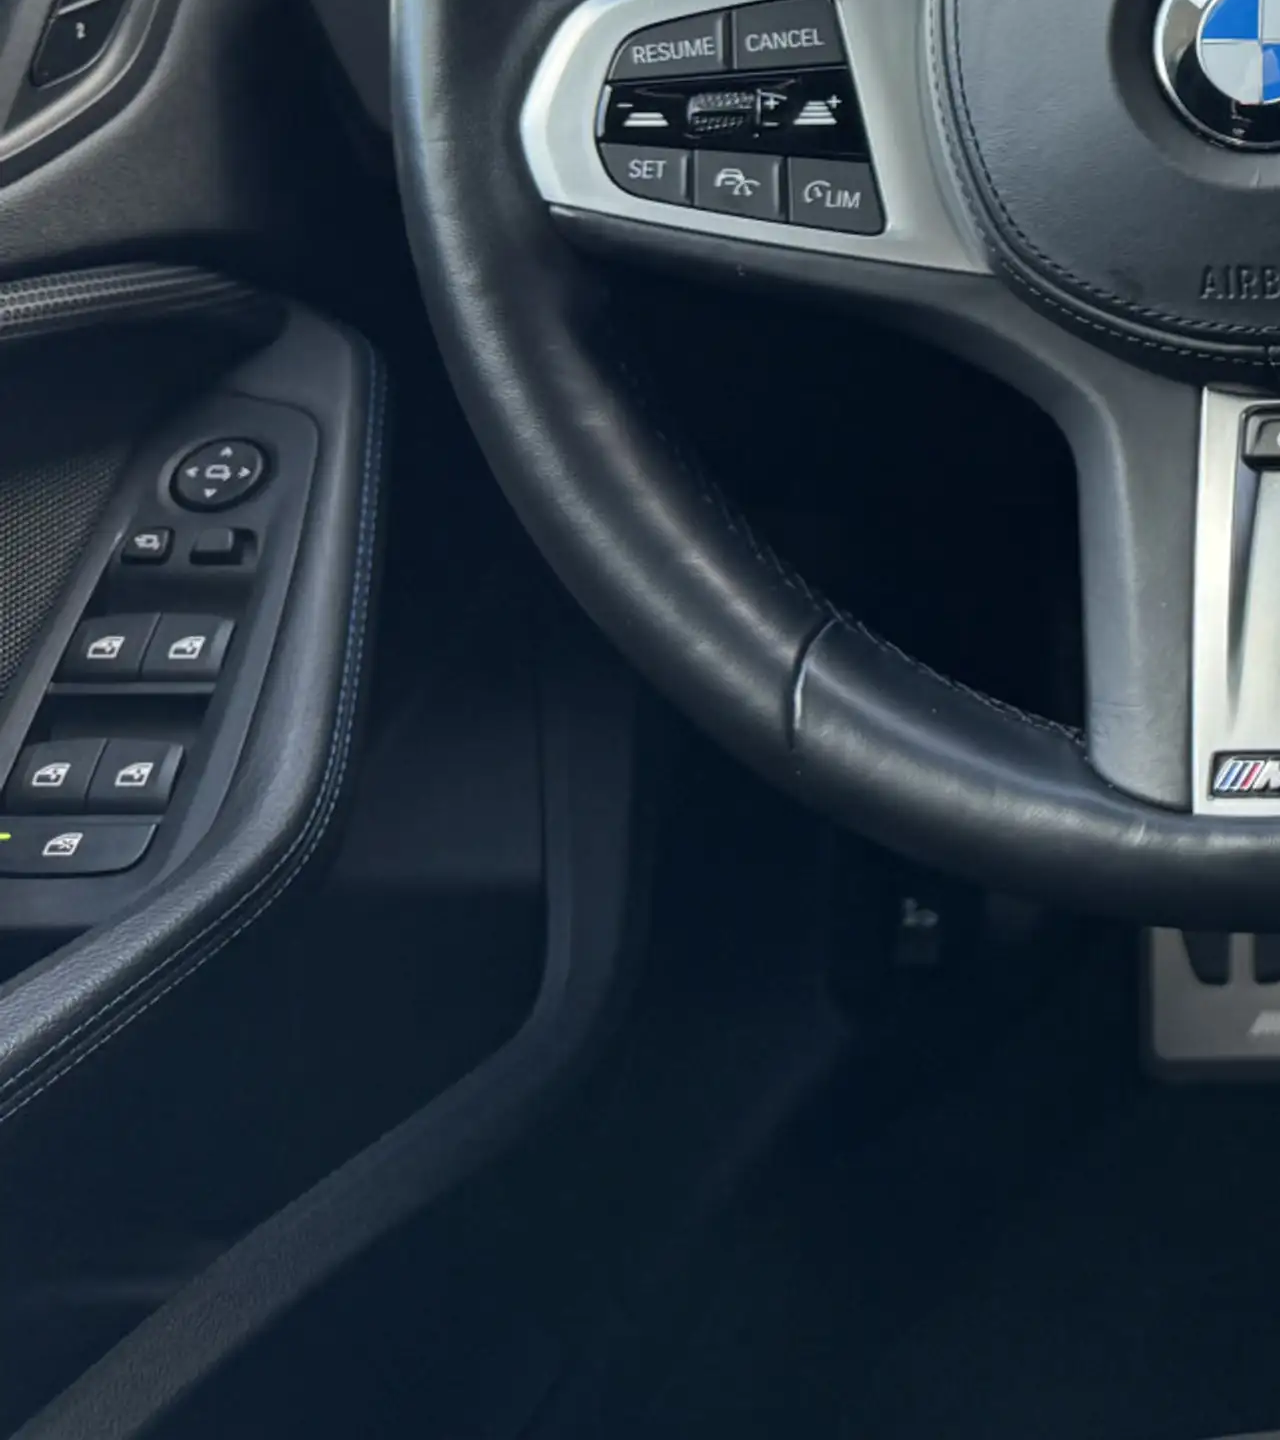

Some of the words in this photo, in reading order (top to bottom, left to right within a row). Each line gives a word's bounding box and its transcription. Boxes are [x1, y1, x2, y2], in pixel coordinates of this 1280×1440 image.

[76, 22, 87, 40] 2
[744, 28, 825, 53] CANCEL
[632, 35, 716, 64] RESUME
[628, 159, 667, 179] SET
[824, 188, 861, 208] LIM
